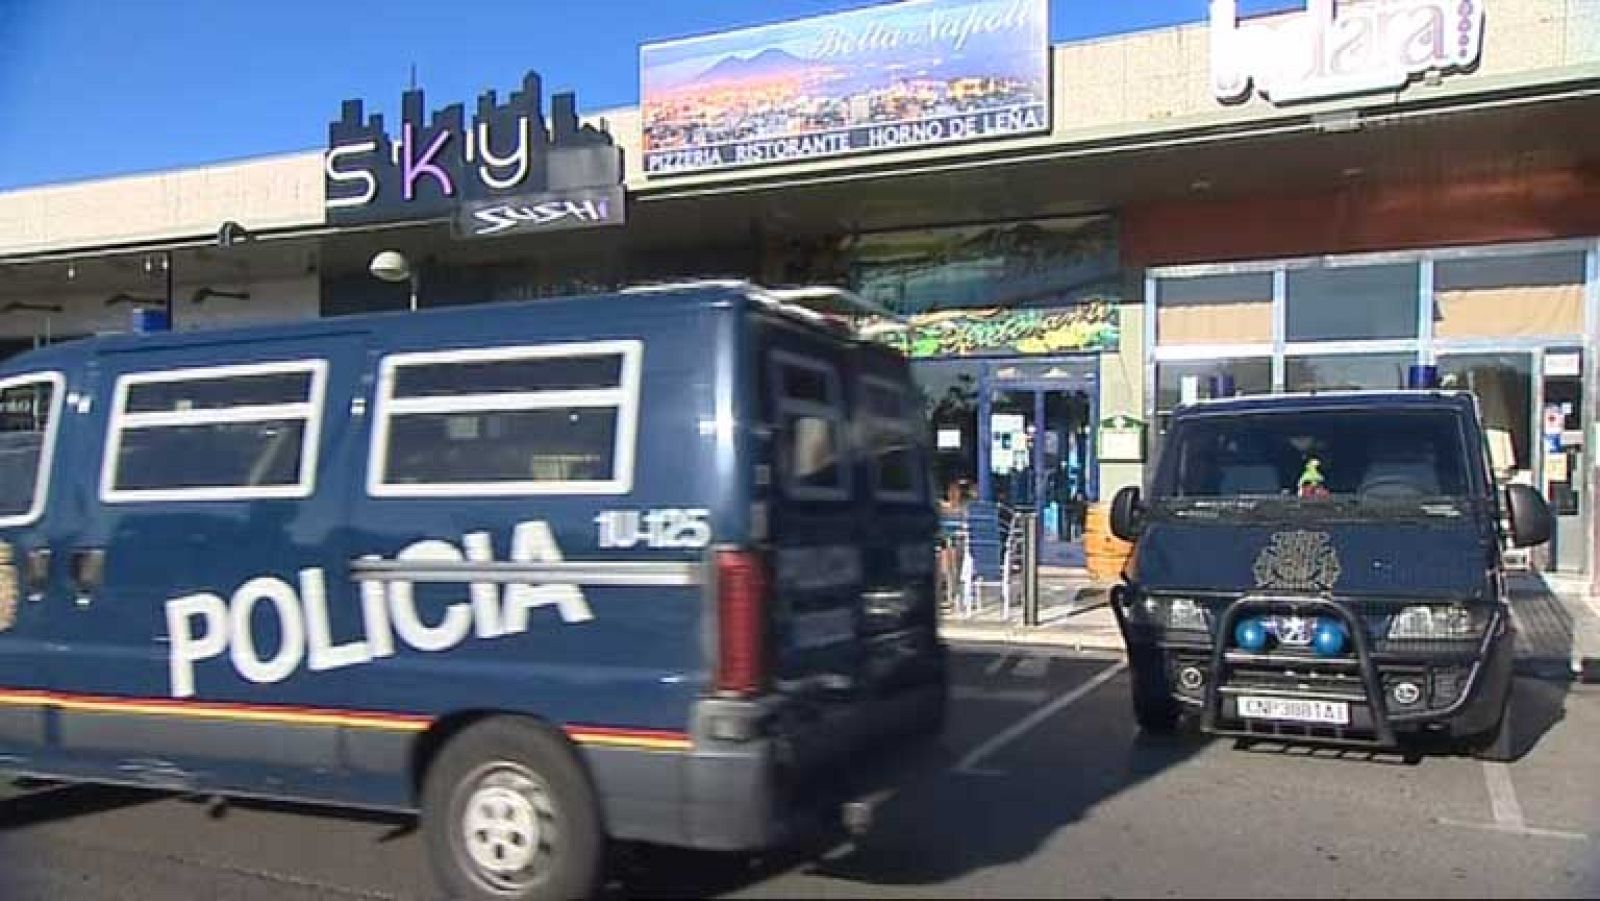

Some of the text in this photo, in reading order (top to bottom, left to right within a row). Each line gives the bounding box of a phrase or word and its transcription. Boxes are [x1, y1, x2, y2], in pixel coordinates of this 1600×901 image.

[649, 149, 721, 174] PIZZERIA
[737, 134, 850, 162] RISTORANTE
[868, 120, 943, 149] HORNO
[948, 117, 977, 142] DE
[594, 509, 712, 547] 1U-125
[166, 520, 594, 698] POLICIA
